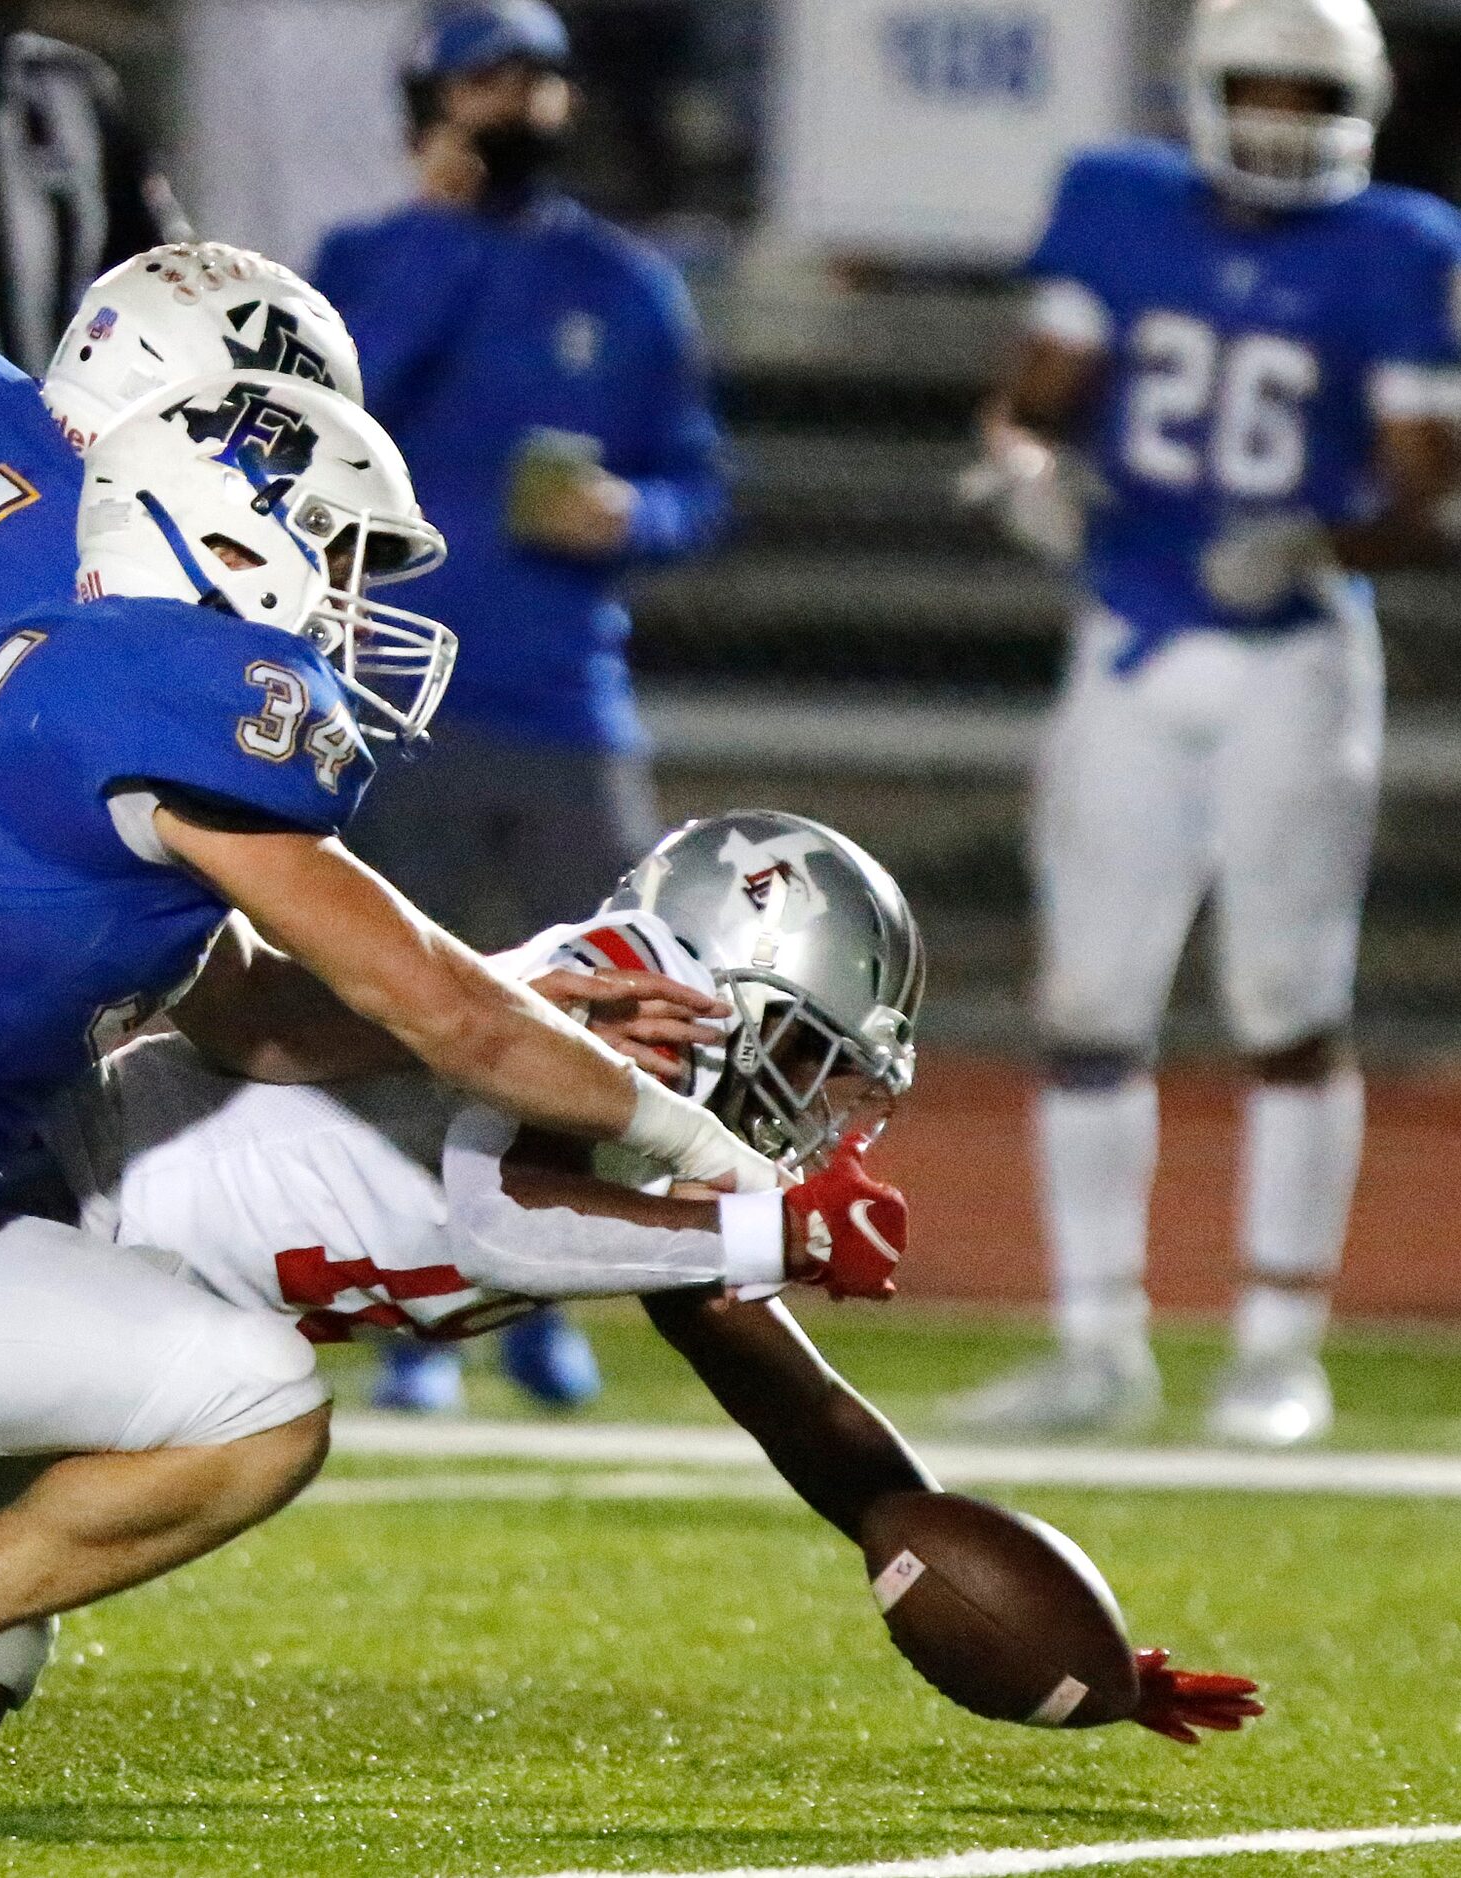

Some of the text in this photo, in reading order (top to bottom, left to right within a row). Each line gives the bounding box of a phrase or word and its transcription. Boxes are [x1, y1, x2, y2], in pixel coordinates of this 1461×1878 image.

[209, 391, 309, 472] F
[1128, 312, 1320, 495] 26
[236, 659, 357, 796] 34
